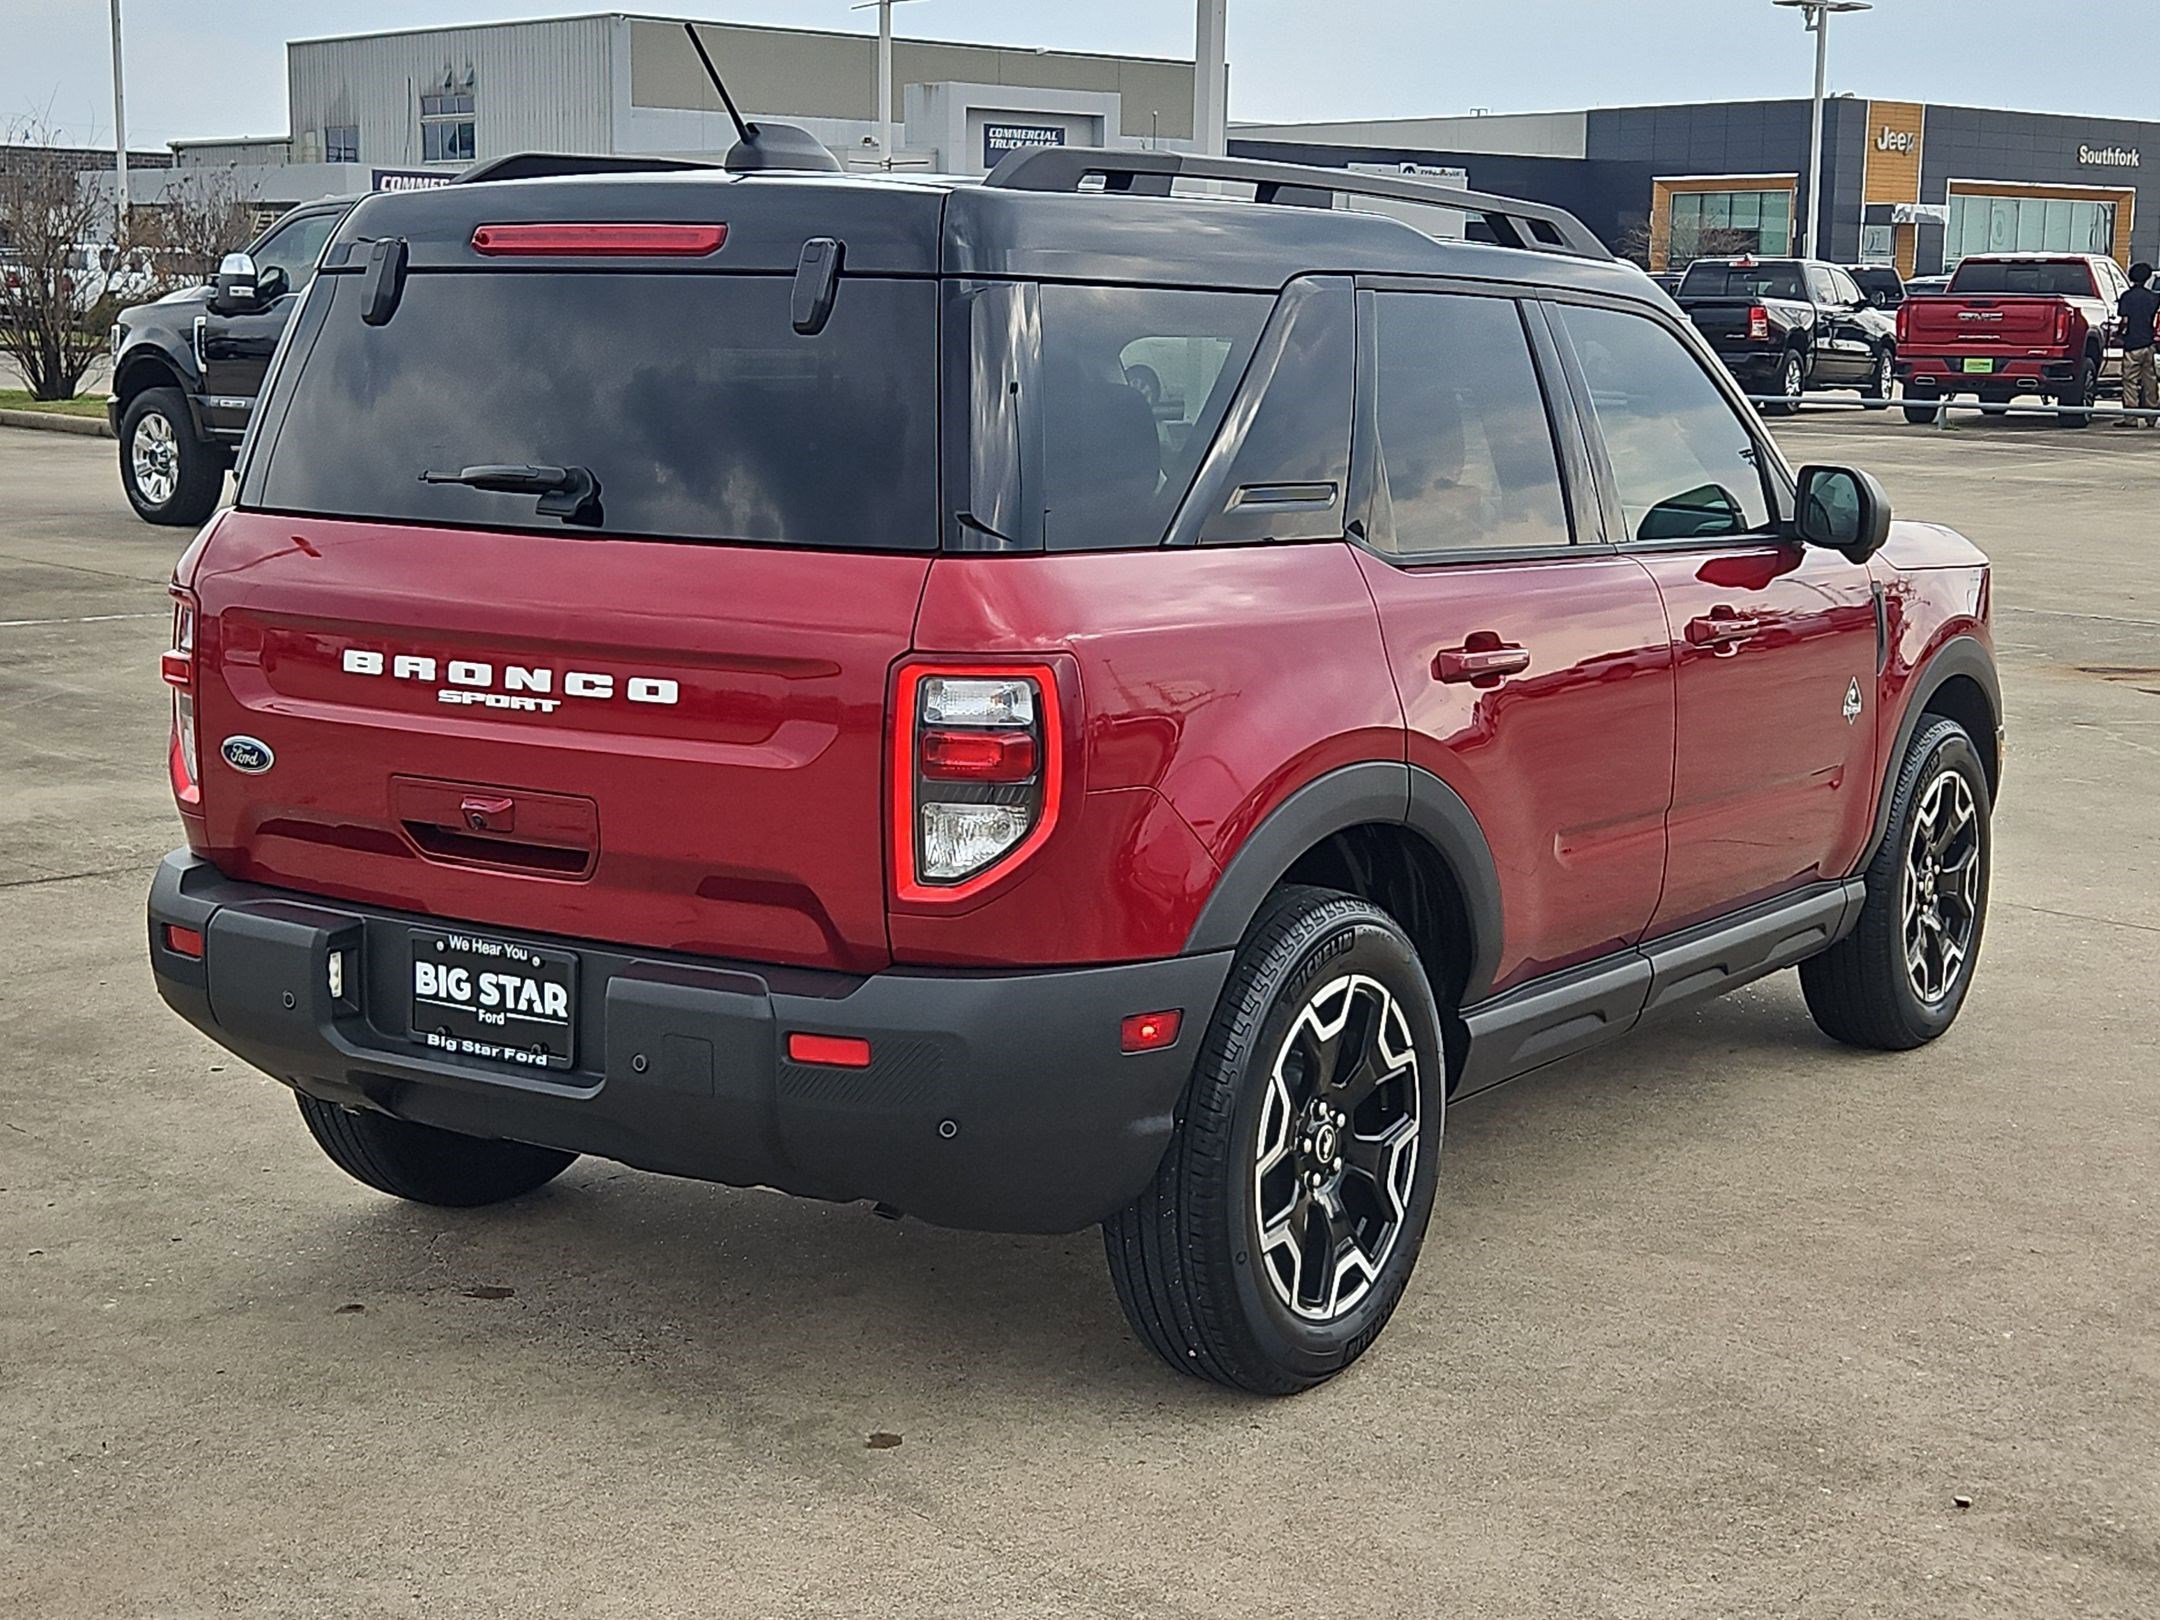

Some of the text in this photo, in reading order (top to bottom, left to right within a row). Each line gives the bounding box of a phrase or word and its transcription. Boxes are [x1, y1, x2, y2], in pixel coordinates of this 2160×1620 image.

[988, 127, 1059, 141] COMMERCIAL
[989, 138, 1024, 150] TRUCK
[1876, 125, 1915, 155] Jeep
[2079, 144, 2140, 167] Southfork
[343, 649, 679, 705] BRONCO
[438, 689, 561, 712] SPORT
[449, 935, 528, 960] We Hear You
[1288, 931, 1354, 1000] MICHELIN
[415, 961, 569, 1018] BIG STAR
[478, 1009, 505, 1026] Ford
[427, 1033, 548, 1066] Big Star Ford
